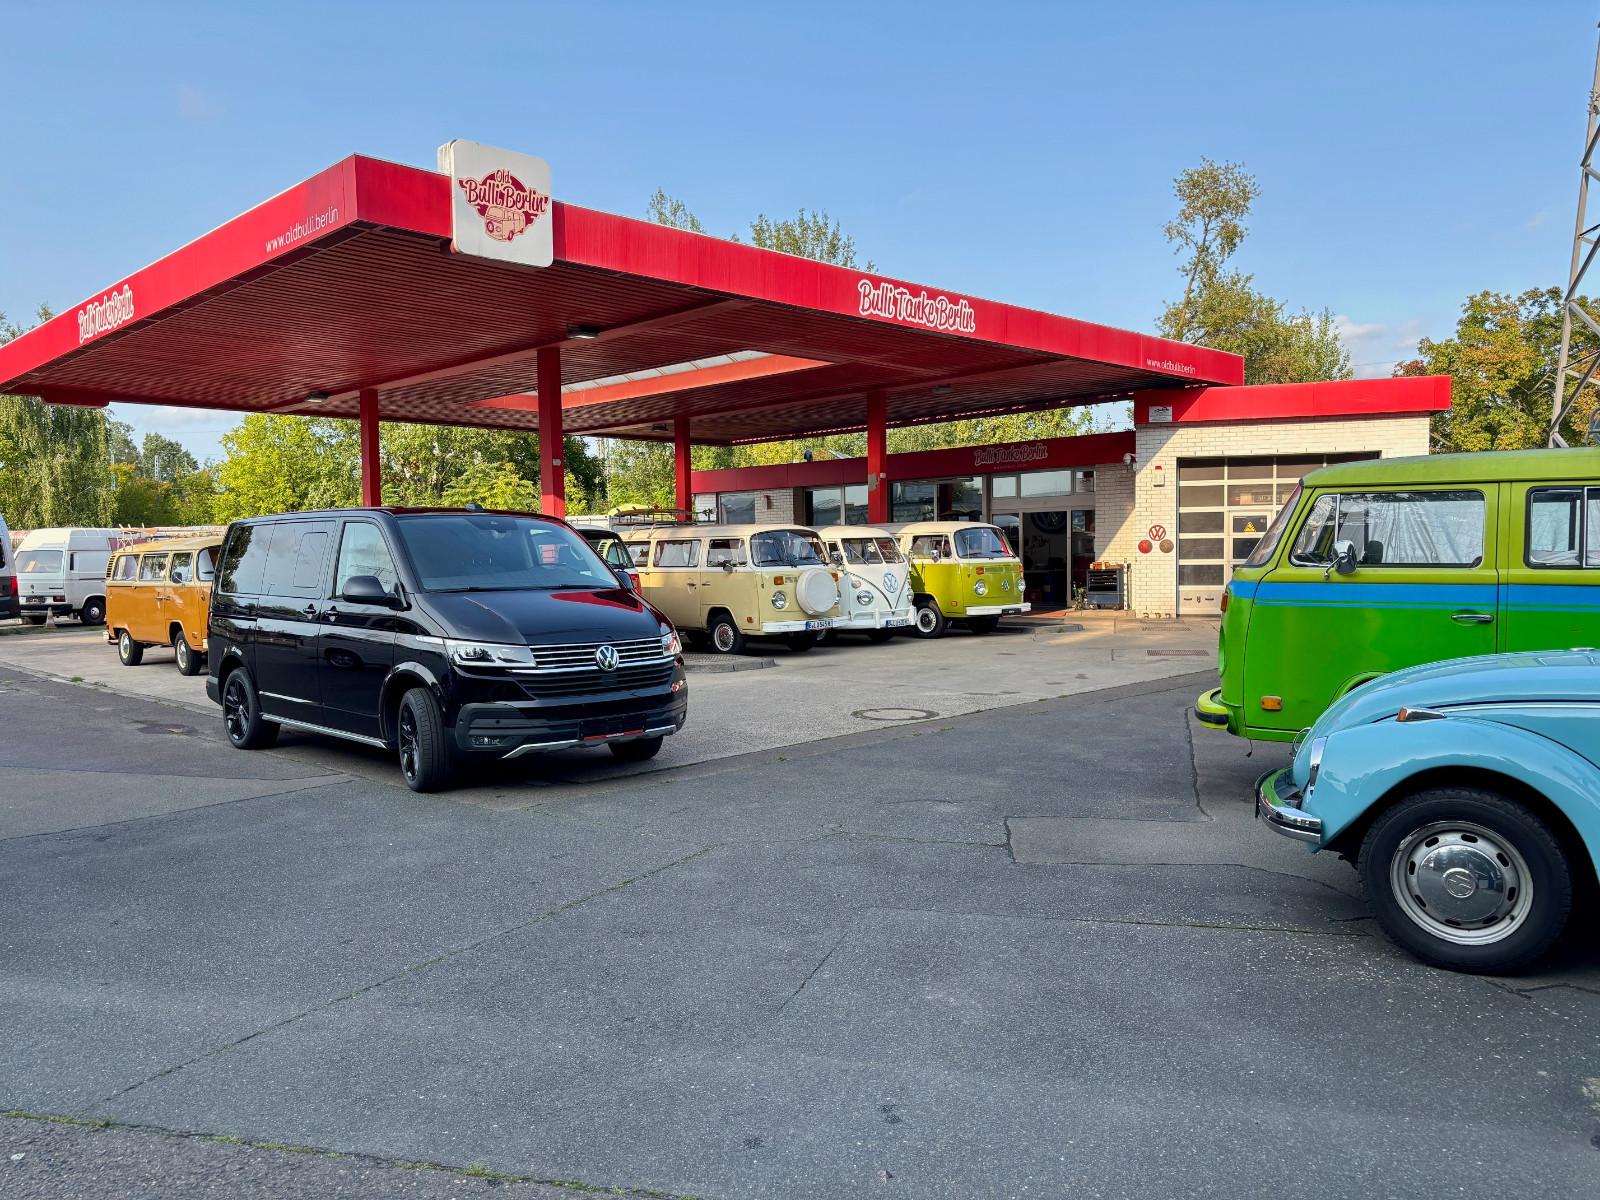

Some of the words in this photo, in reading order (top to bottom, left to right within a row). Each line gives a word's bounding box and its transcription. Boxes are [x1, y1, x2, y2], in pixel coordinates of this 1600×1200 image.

[465, 178, 503, 206] Bulli
[502, 185, 546, 213] Berlin
[495, 169, 511, 183] Old
[265, 206, 339, 253] www.oldbulli.berlin
[858, 279, 895, 318] Bulli
[895, 288, 937, 327] Tanke
[935, 295, 976, 333] Berlin
